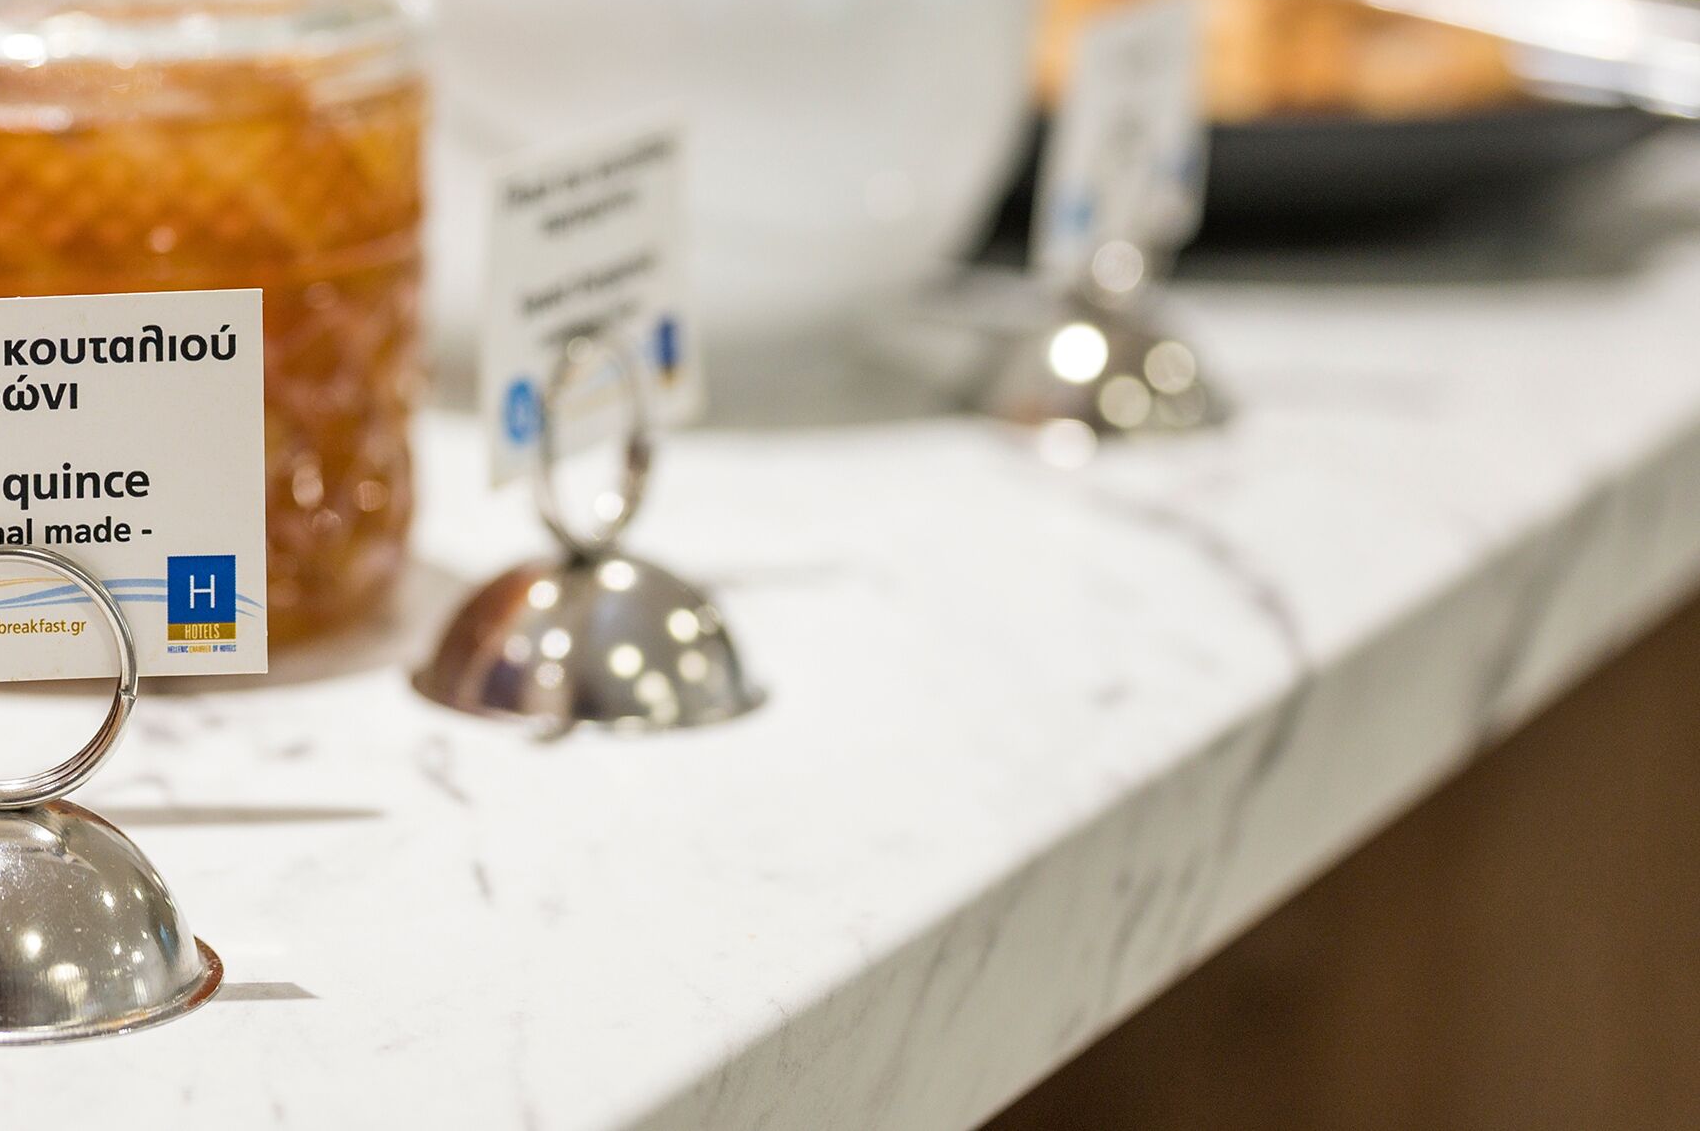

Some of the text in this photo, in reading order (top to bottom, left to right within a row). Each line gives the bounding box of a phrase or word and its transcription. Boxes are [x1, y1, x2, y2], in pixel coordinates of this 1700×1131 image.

[3, 324, 238, 366] κουταλιού
[2, 462, 151, 511] quince
[44, 515, 132, 545] made
[189, 573, 216, 610] H
[184, 623, 221, 640] HOTELS
